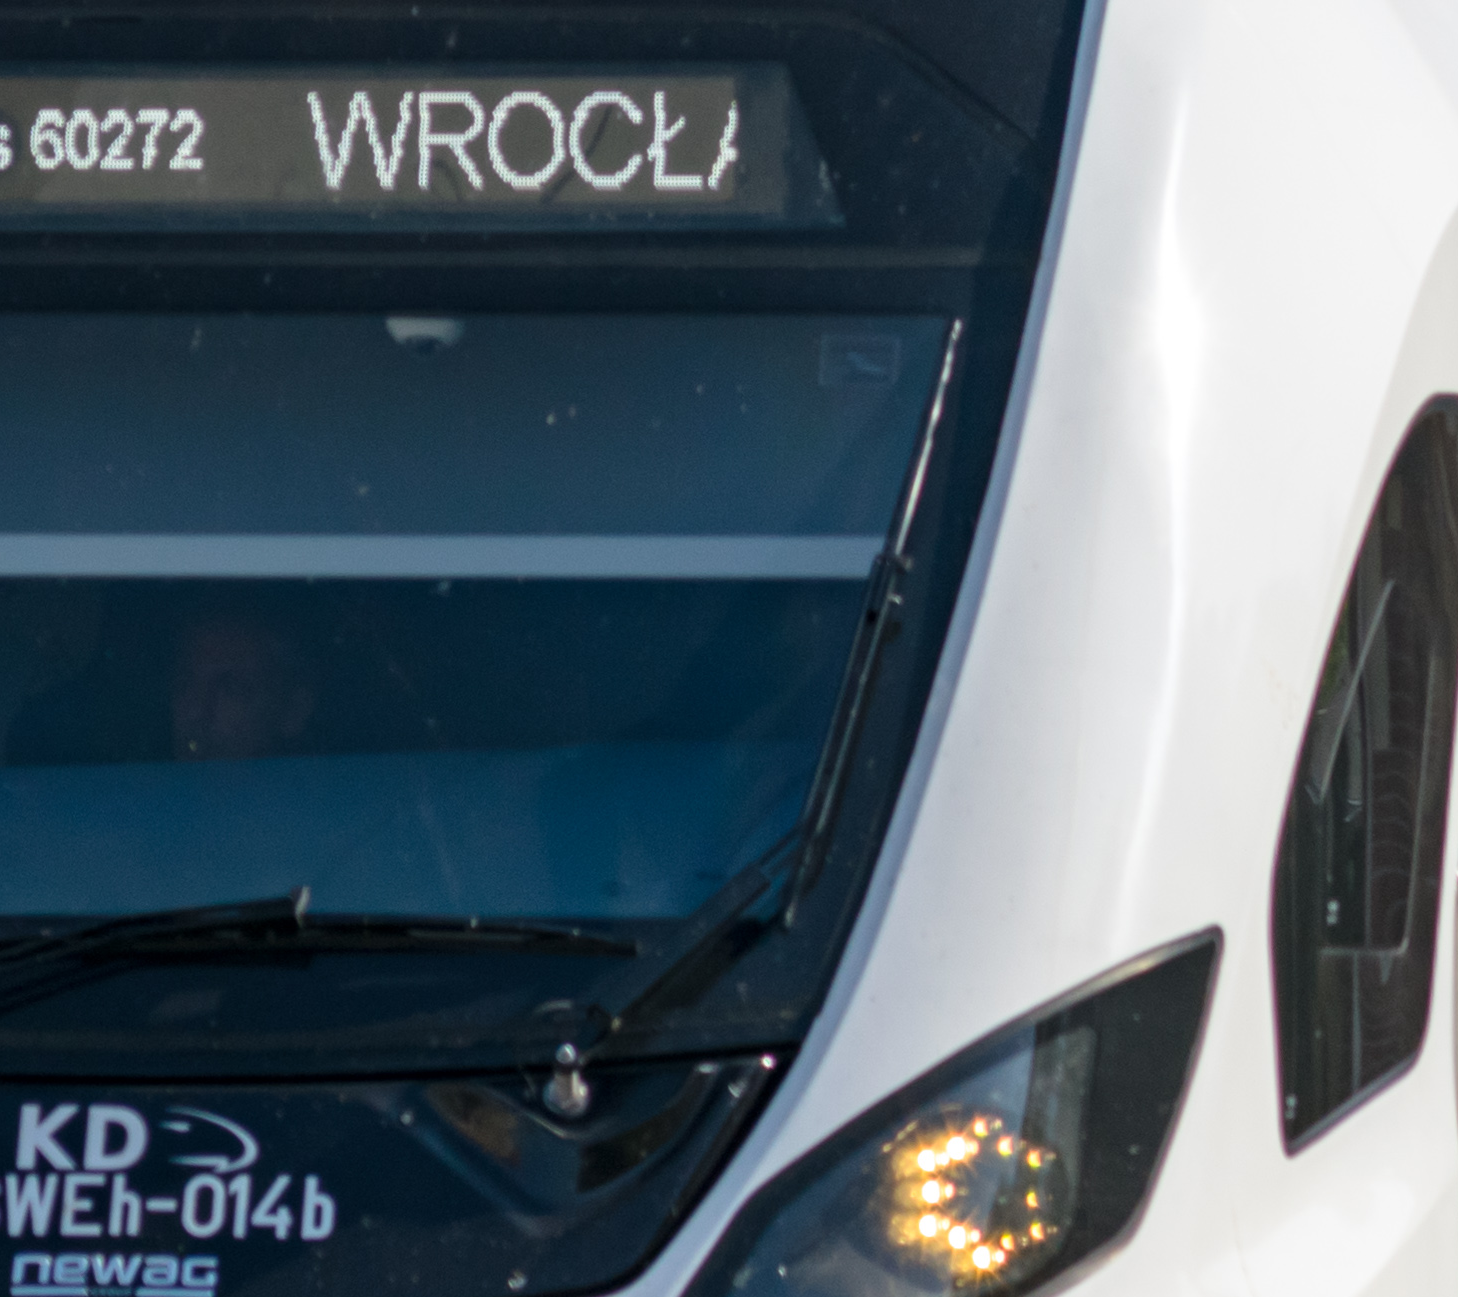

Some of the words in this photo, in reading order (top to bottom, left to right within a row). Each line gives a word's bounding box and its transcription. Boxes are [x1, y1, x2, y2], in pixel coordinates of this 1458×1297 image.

[29, 108, 204, 171] 60272
[15, 1103, 149, 1171] KD
[11, 1252, 219, 1288] newag
